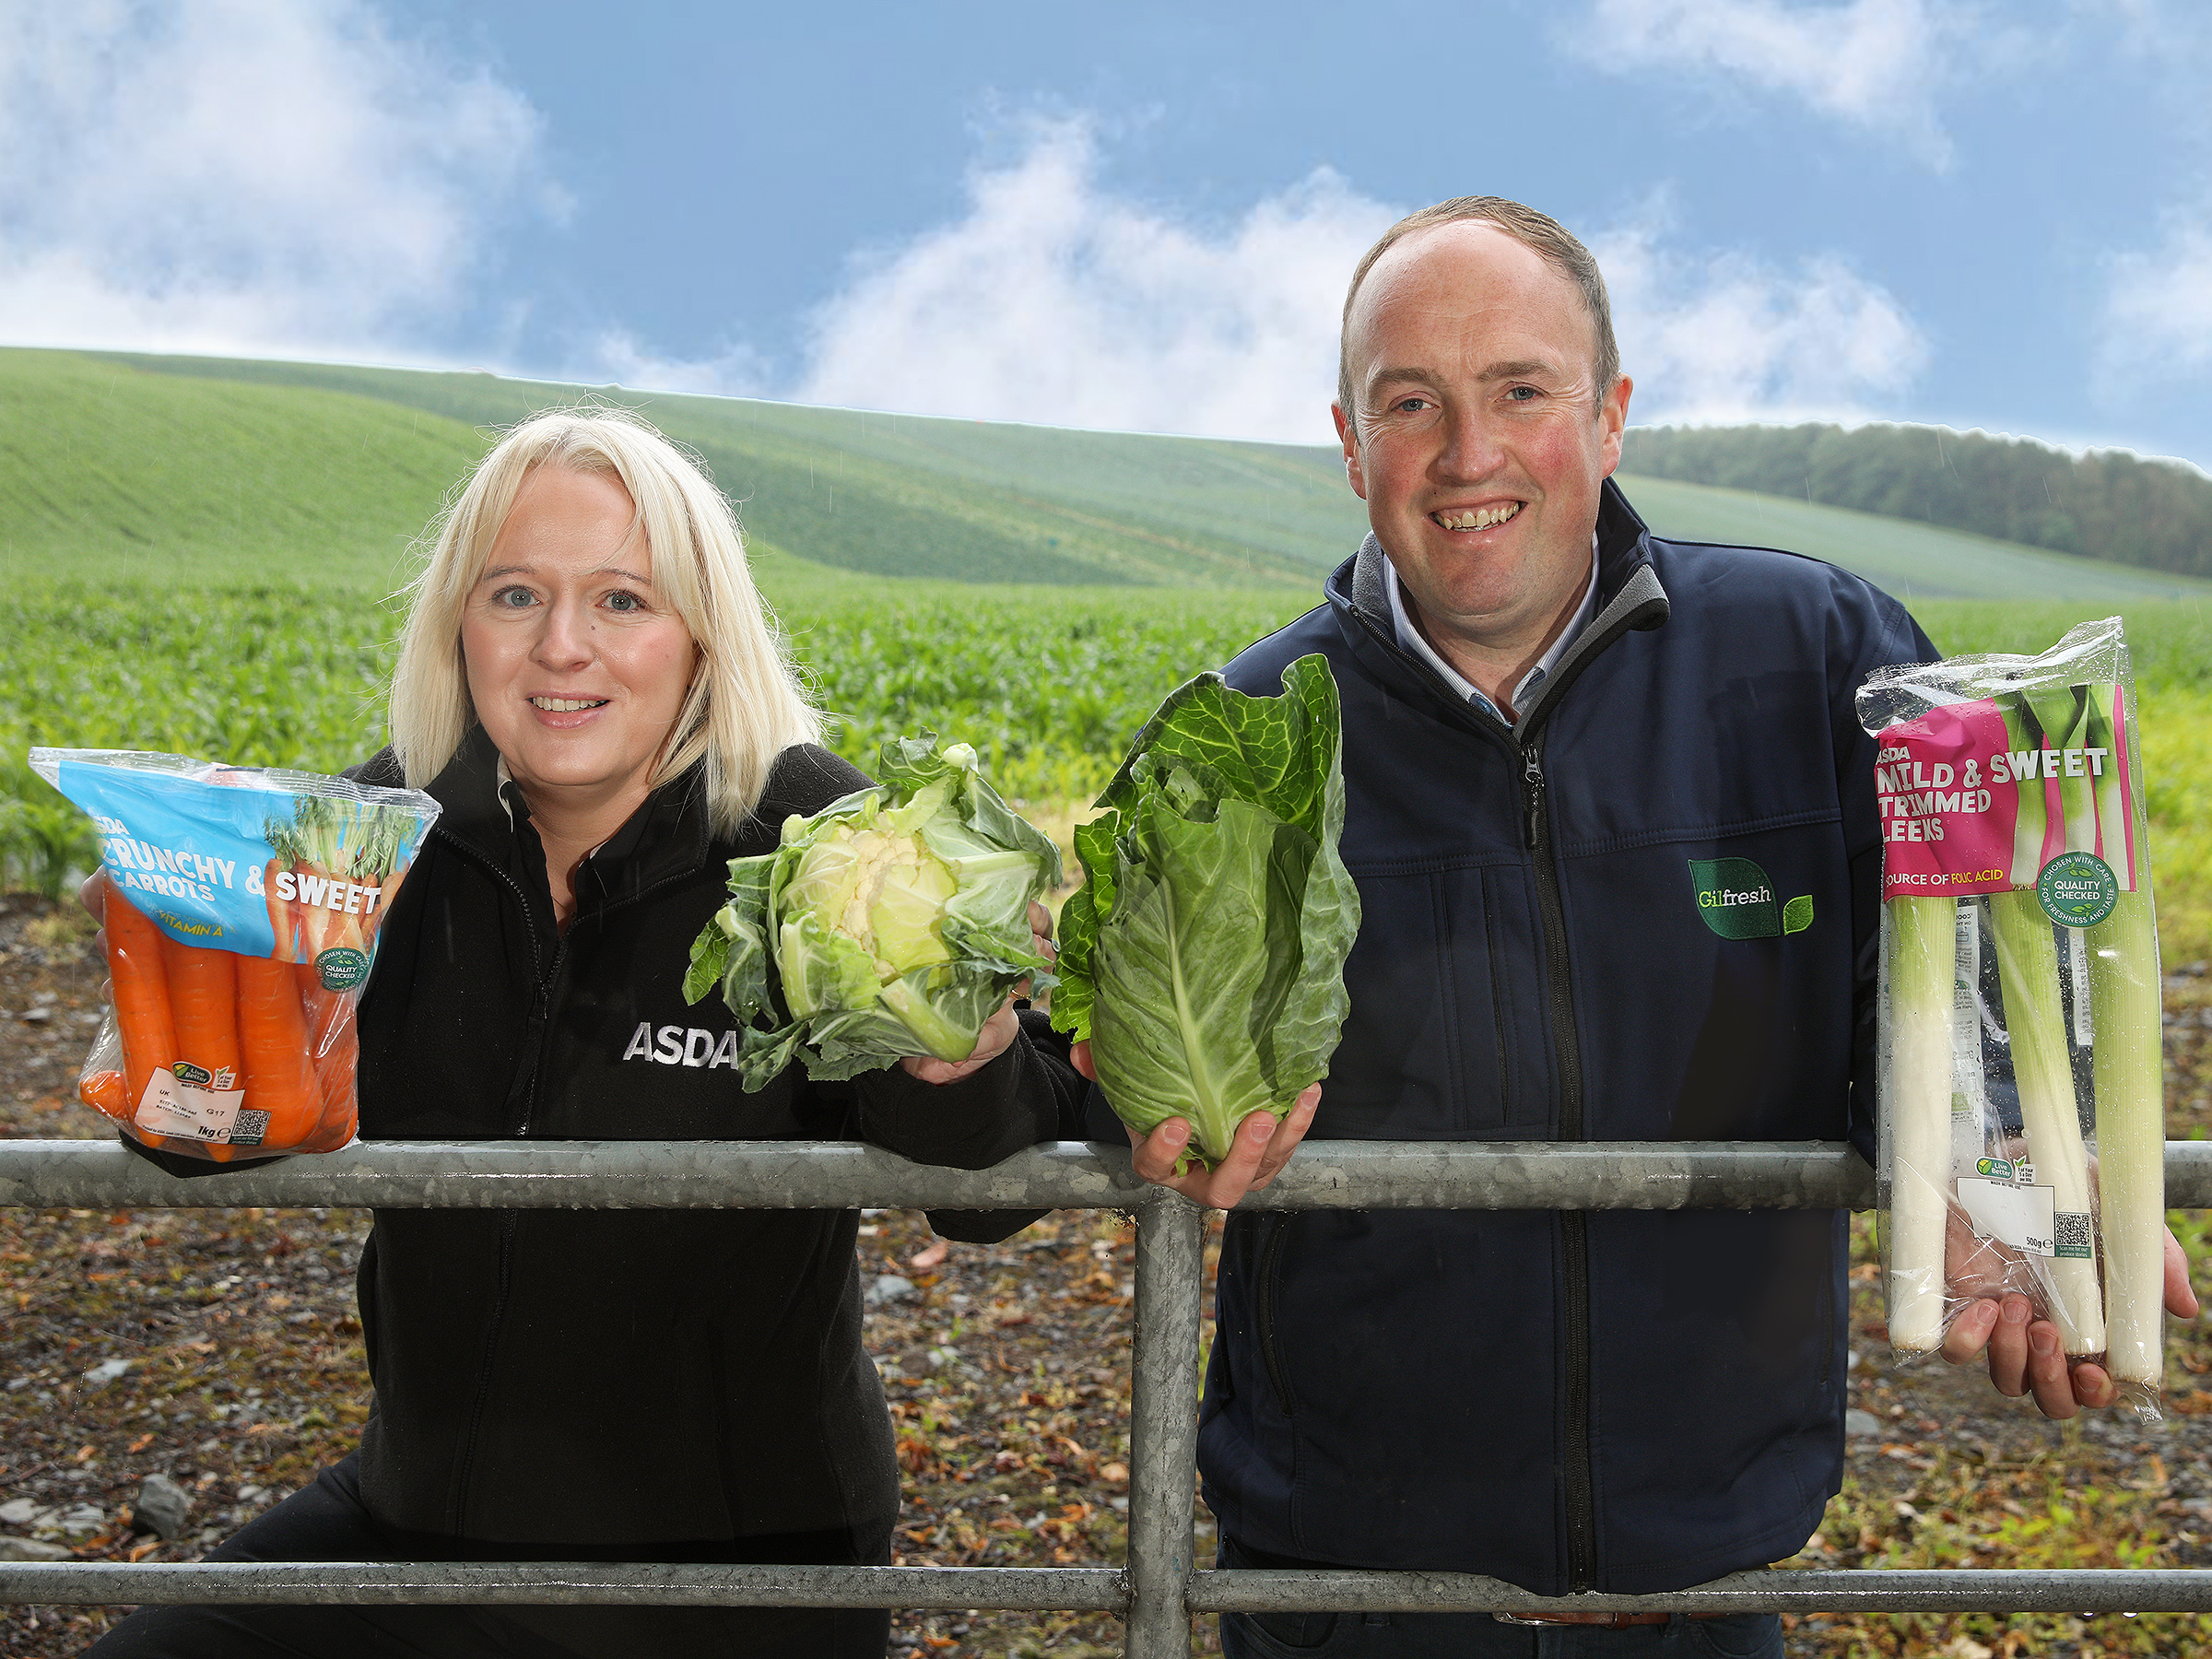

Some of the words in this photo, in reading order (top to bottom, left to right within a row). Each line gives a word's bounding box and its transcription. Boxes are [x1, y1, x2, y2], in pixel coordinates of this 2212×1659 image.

[1876, 746, 1911, 765] ASDA
[1877, 761, 1955, 794] MILD
[1963, 759, 1983, 788] &
[1990, 747, 2108, 783] SWEET
[1877, 789, 1992, 818] TRIMMED
[1881, 818, 1945, 843] LEEKS
[2044, 857, 2072, 880] CHOSEN
[2074, 856, 2093, 865] WITH
[2095, 864, 2112, 882] CARE
[96, 839, 236, 888] CRUNCHY
[244, 865, 265, 897] &
[276, 871, 382, 914] SWEET
[1930, 874, 1948, 885] OF
[1951, 871, 1972, 884] FOLIC
[1974, 869, 2004, 881] ACID
[108, 869, 216, 901] CARROTS
[2054, 880, 2100, 890] QUALITY
[1699, 886, 1771, 908] Gilfresh
[2054, 890, 2100, 900] CHECKED
[2041, 888, 2051, 903] FOR
[2047, 903, 2088, 924] FRESHNESS
[2089, 909, 2105, 922] AND
[2102, 888, 2114, 910] TASTE
[211, 925, 223, 937] A
[319, 950, 341, 964] CHOSEN
[325, 964, 358, 972] QUALITY
[324, 971, 355, 979] CHECKED
[622, 1021, 739, 1070] ASDA
[185, 1072, 207, 1082] Better
[191, 1067, 206, 1077] Live
[159, 1088, 171, 1097] UK
[206, 1108, 225, 1117] G17
[197, 1125, 216, 1137] 1kg
[1991, 1168, 2011, 1177] Better
[1994, 1162, 2007, 1171] Live
[2026, 1237, 2041, 1249] 500g
